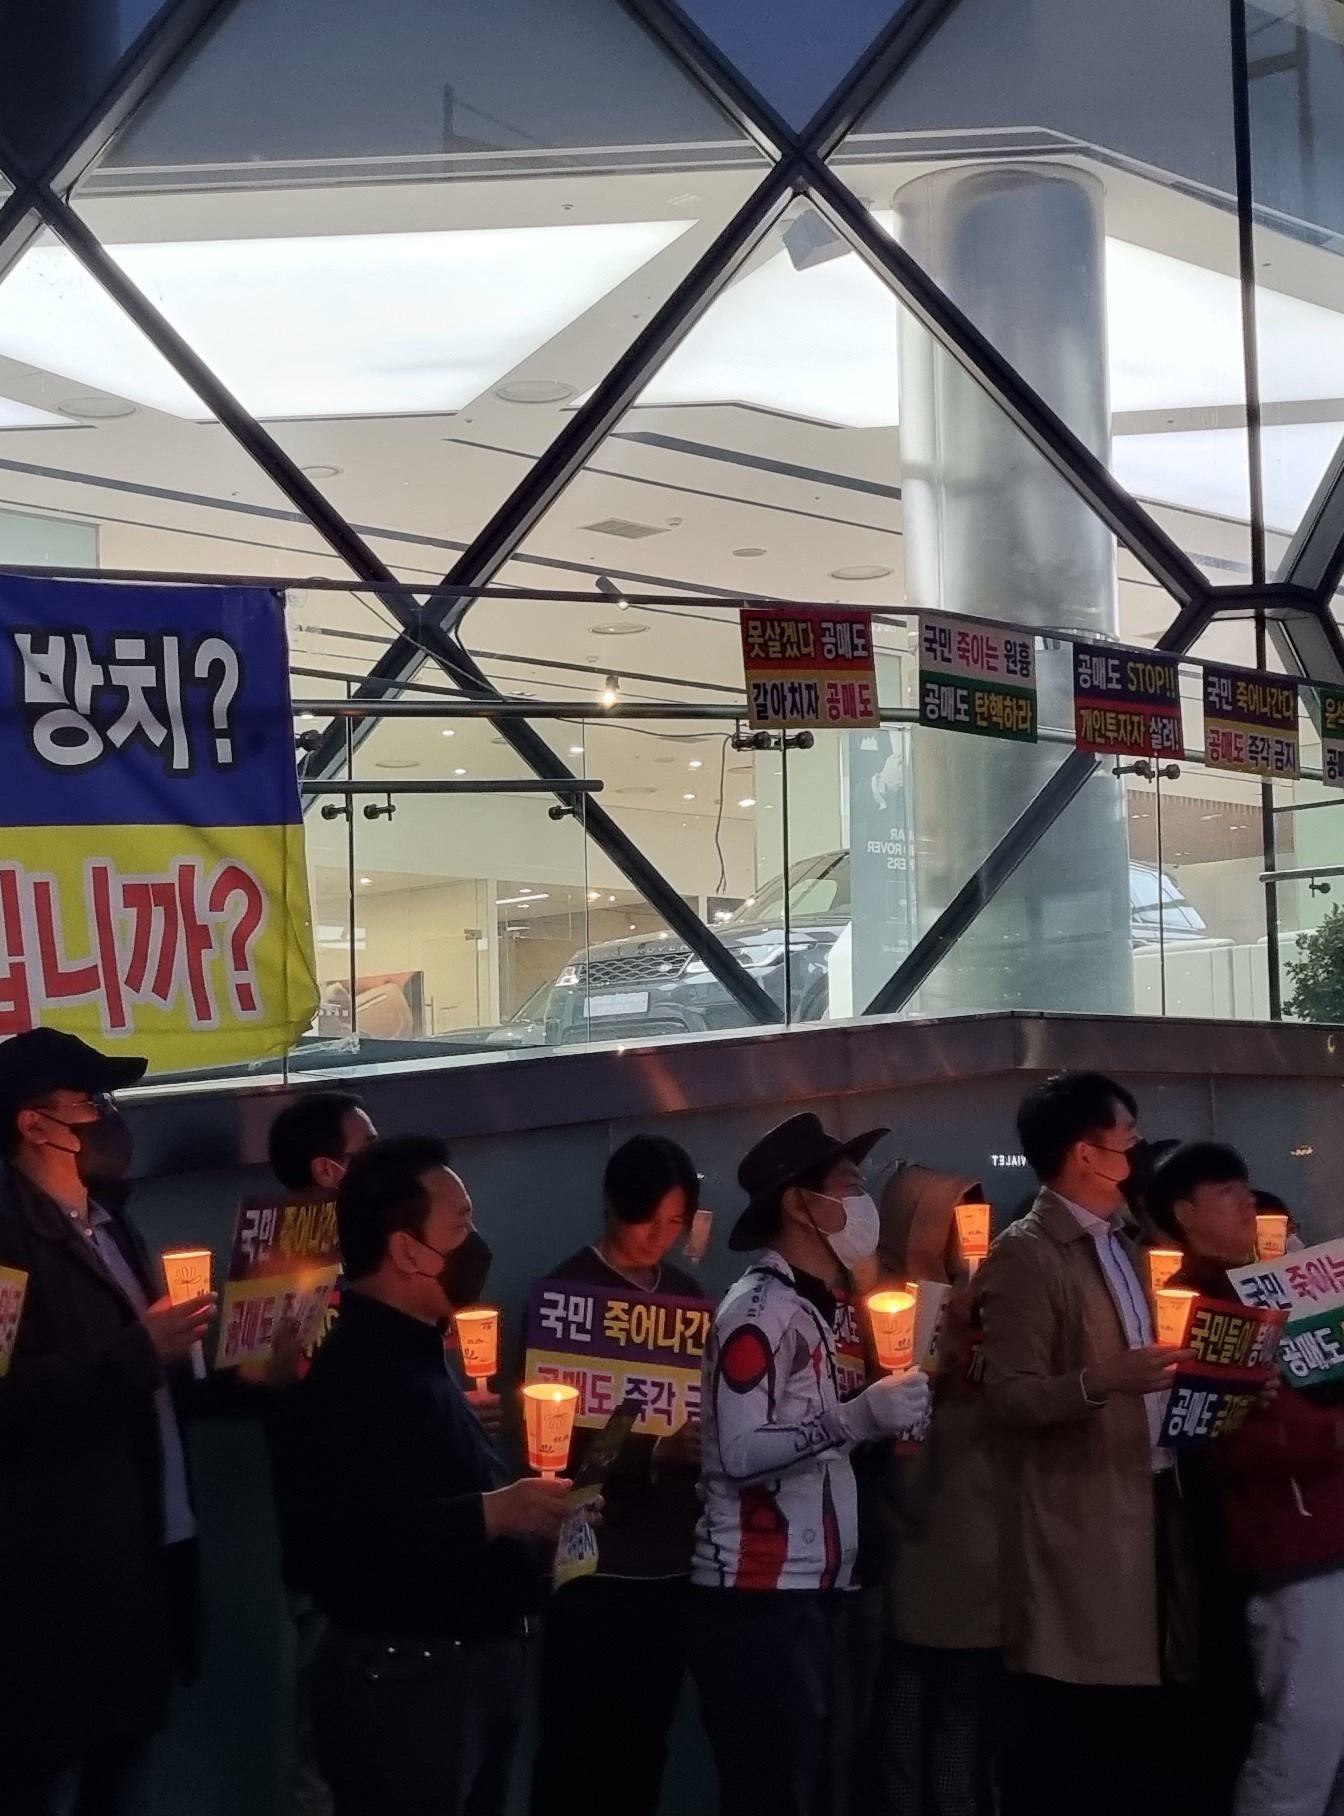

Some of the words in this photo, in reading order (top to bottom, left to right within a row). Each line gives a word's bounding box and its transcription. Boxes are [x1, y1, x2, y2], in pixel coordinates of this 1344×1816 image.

[747, 619, 815, 659] 못살겠다
[820, 621, 869, 660] 공매도
[923, 624, 952, 664] 국민
[957, 630, 999, 672] 죽이는
[1003, 638, 1031, 678] 원흉
[1077, 652, 1122, 691] 공매도
[1126, 660, 1176, 699] STOP!!
[1207, 675, 1233, 711] 국민
[1236, 681, 1294, 720] 죽어나간다
[14, 632, 241, 770] 방치?
[752, 682, 819, 720] 갈아치자
[826, 682, 874, 720] 공매도
[923, 681, 971, 722] 공매도
[974, 690, 1033, 734] 탄핵하라
[1079, 708, 1146, 748] 개인투자자
[1208, 728, 1245, 764] 공매도
[1248, 735, 1270, 768] 즉각
[1274, 739, 1296, 772] 금지
[240, 1207, 278, 1263] 국민
[1239, 1271, 1293, 1311] 국민
[539, 1291, 595, 1343] 국민
[603, 1299, 712, 1356] 죽어나간
[1167, 1387, 1219, 1437] 공매도
